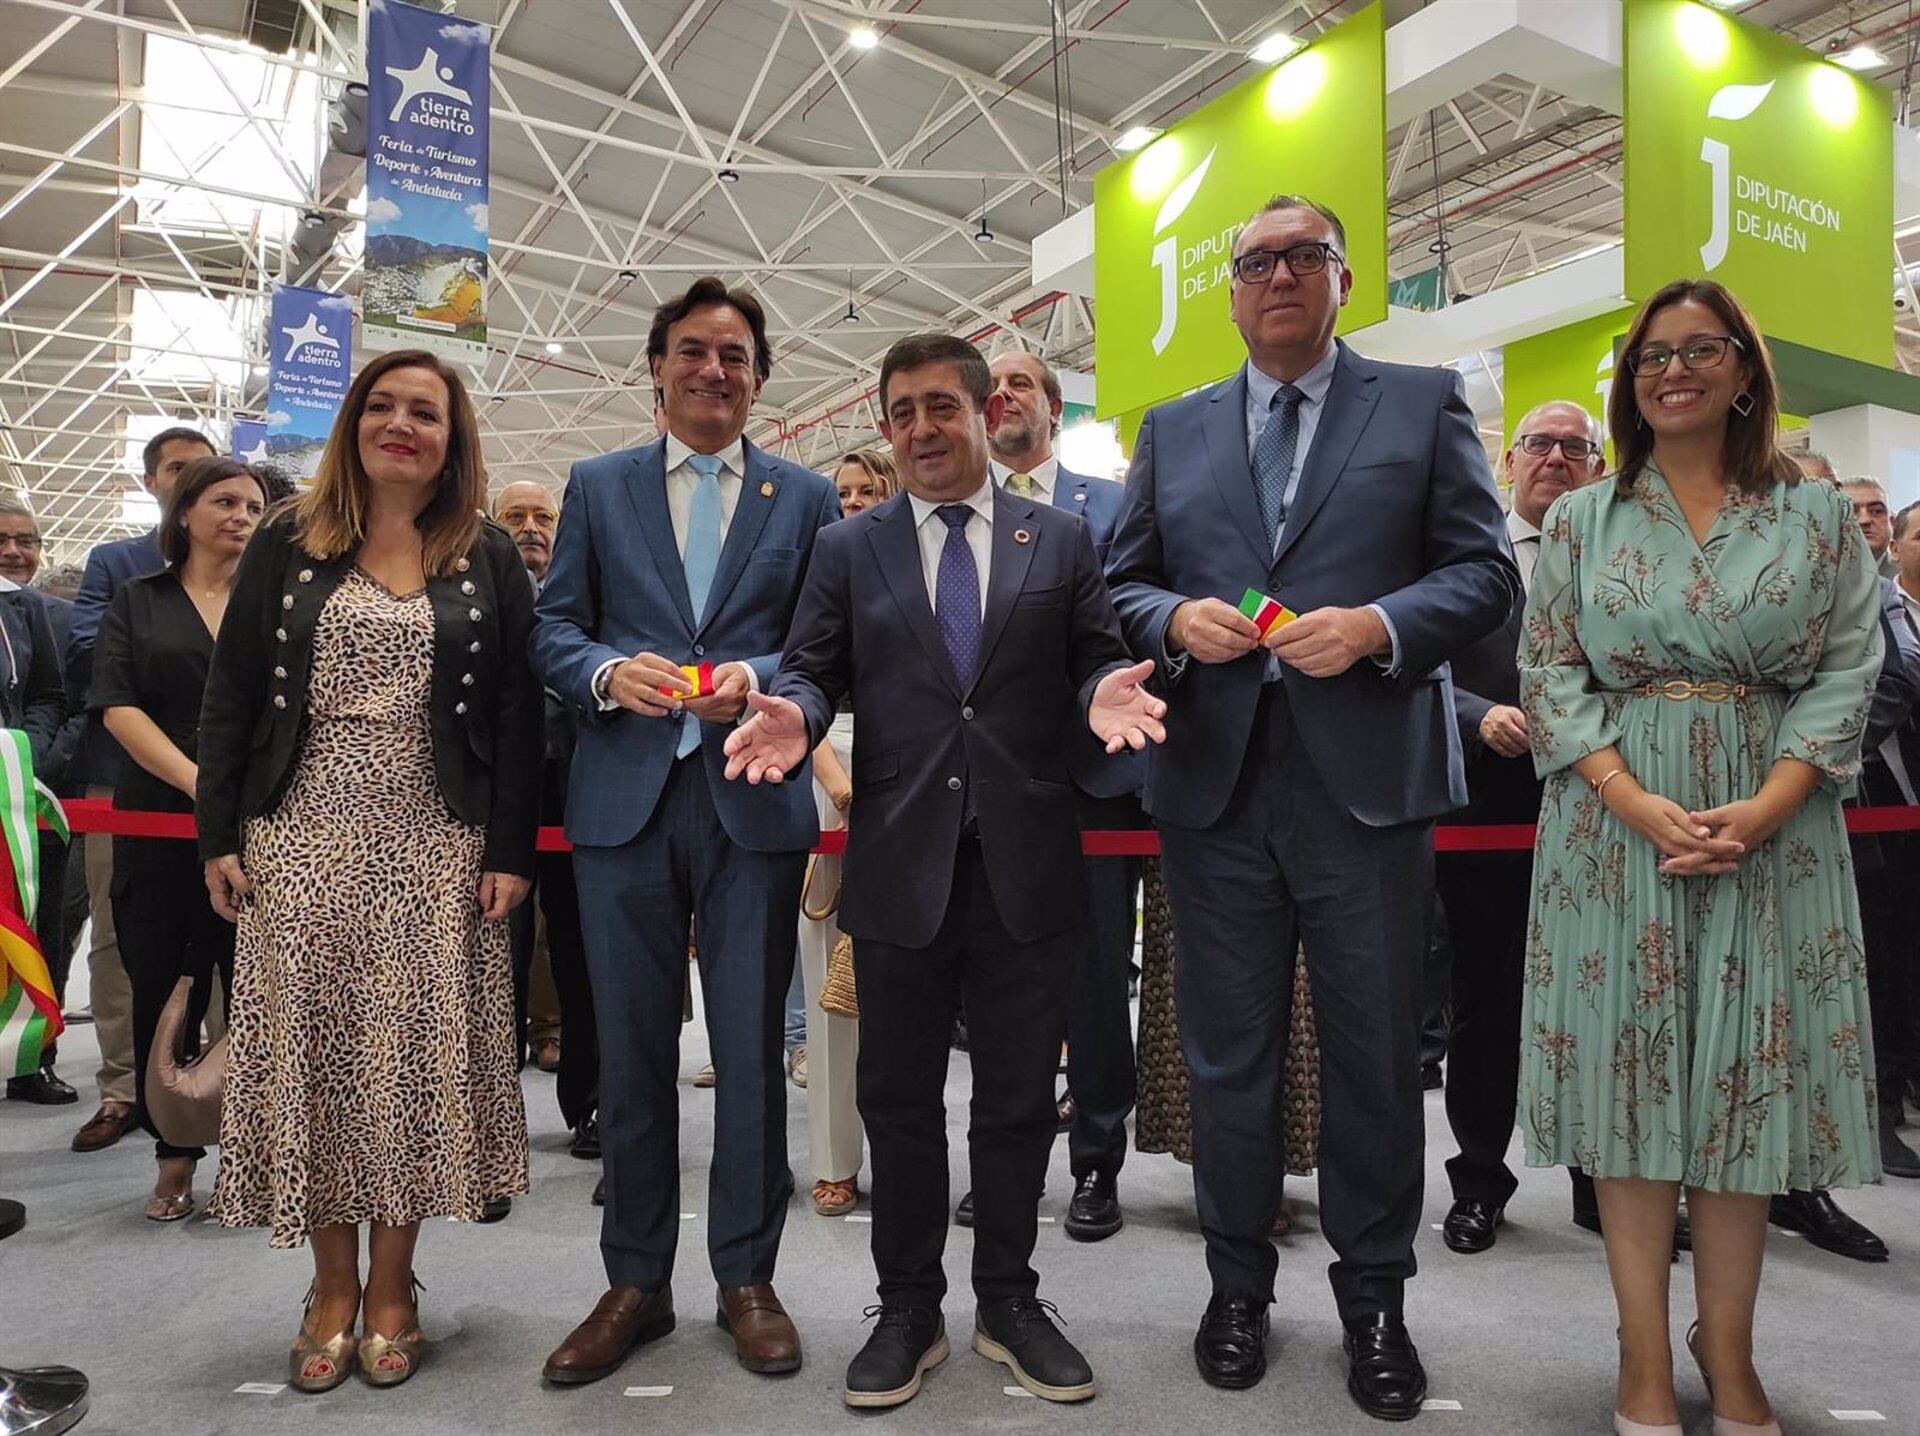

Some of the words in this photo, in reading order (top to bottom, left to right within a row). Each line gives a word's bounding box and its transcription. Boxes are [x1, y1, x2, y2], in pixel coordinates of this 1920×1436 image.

[409, 111, 475, 135] adentro
[420, 97, 470, 122] tierra
[378, 134, 415, 153] Feria
[425, 145, 477, 167] Turismo
[373, 152, 422, 175] Deporte
[429, 165, 483, 187] Aventura
[1736, 174, 1840, 232] DIPUTACIÓN
[1182, 221, 1246, 270] DIPUT
[1736, 209, 1761, 239] DE
[1763, 219, 1806, 253] JAÉN
[1182, 270, 1208, 300] DE
[1209, 261, 1232, 289] JA
[297, 354, 342, 368] adentro
[304, 344, 338, 359] tierra
